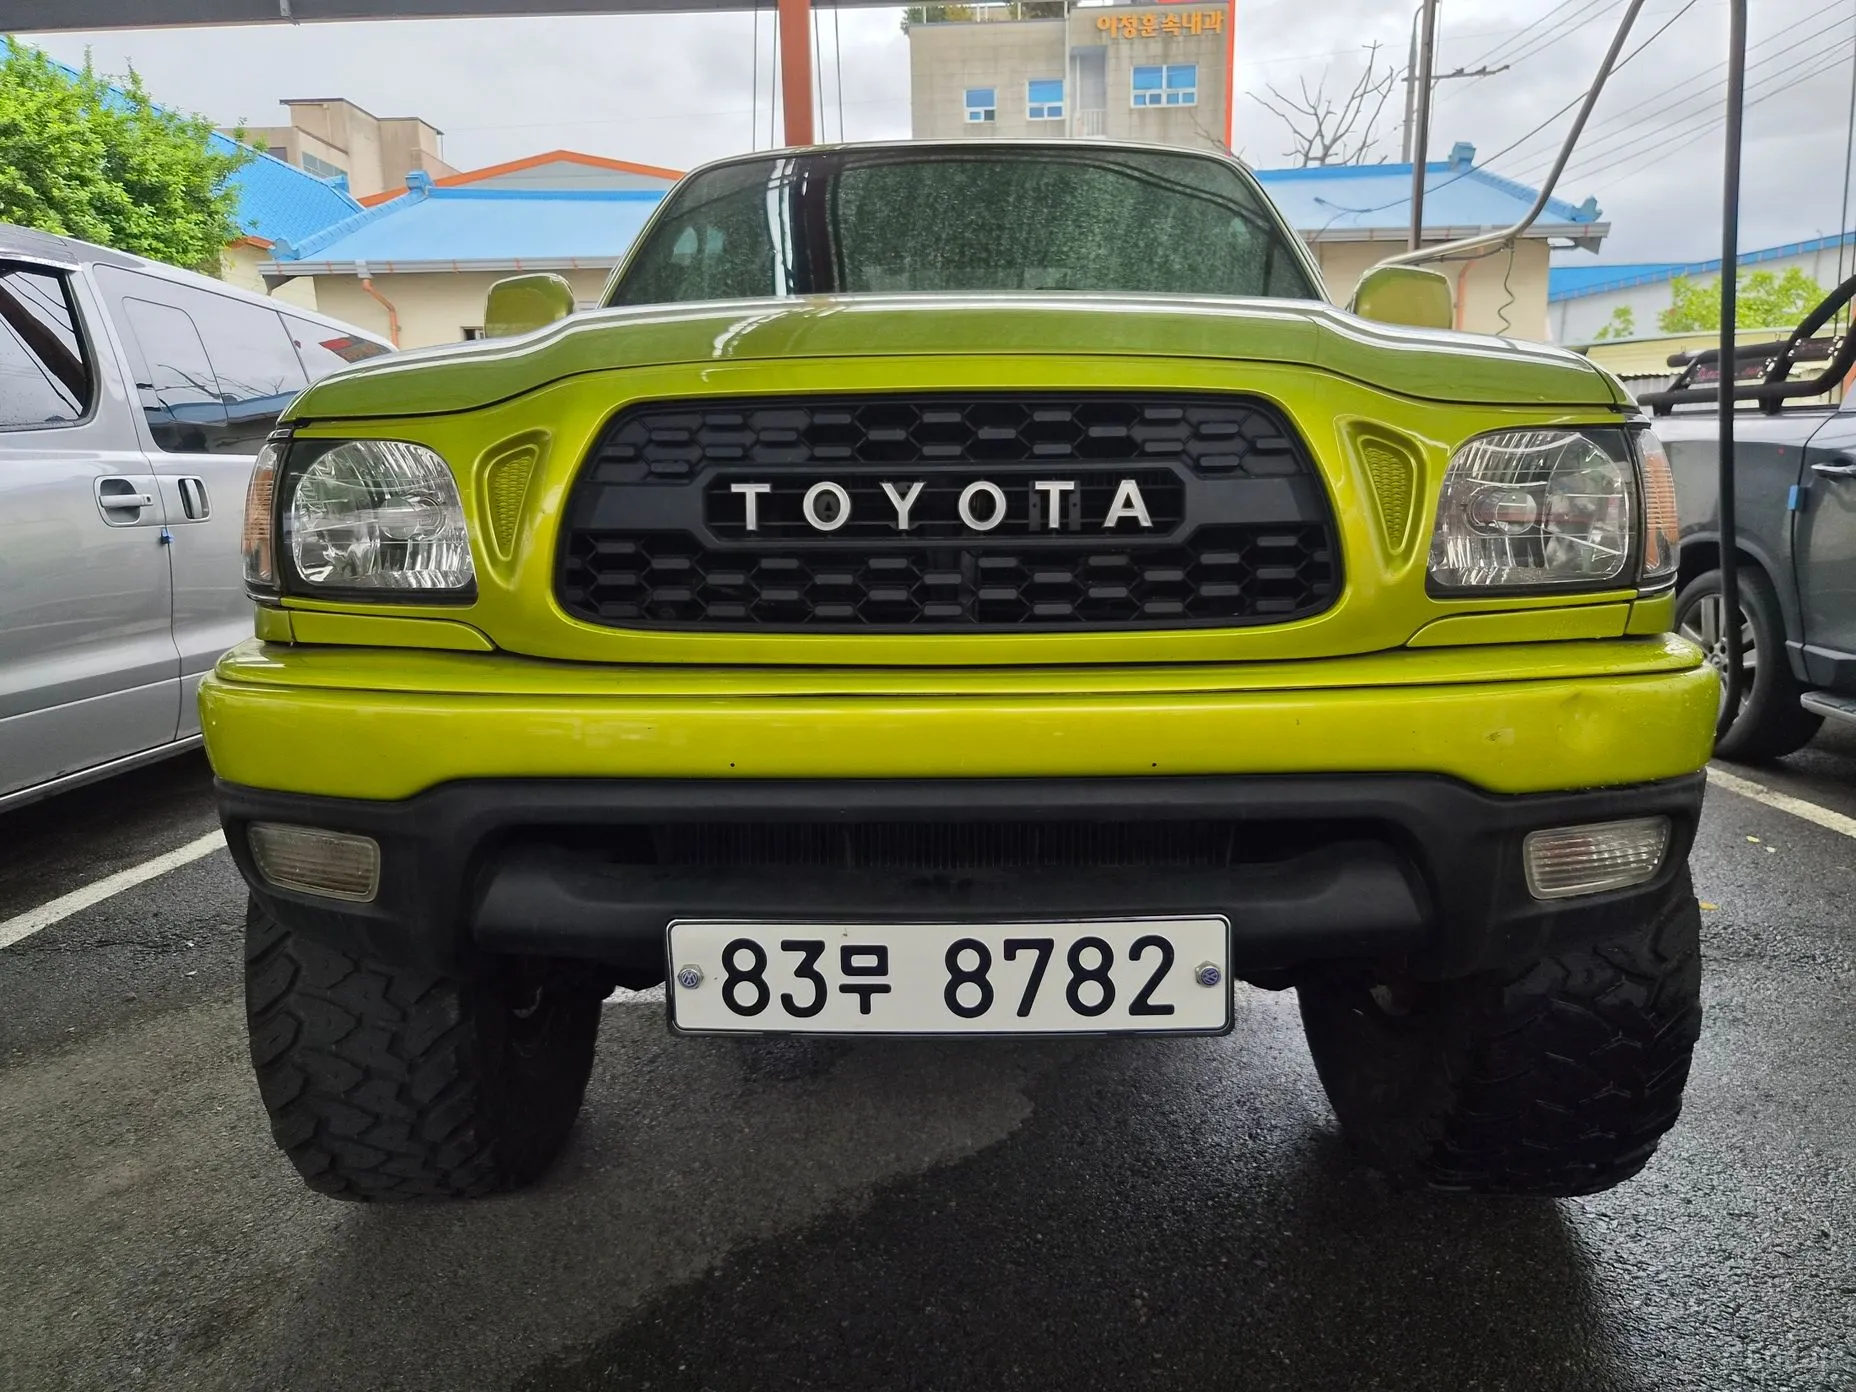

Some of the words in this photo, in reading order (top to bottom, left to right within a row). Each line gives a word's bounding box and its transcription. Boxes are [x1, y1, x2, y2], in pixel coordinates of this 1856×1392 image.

[730, 479, 1153, 531] TOYOTA
[721, 937, 892, 1018] 83무
[943, 934, 1175, 1019] 8782
